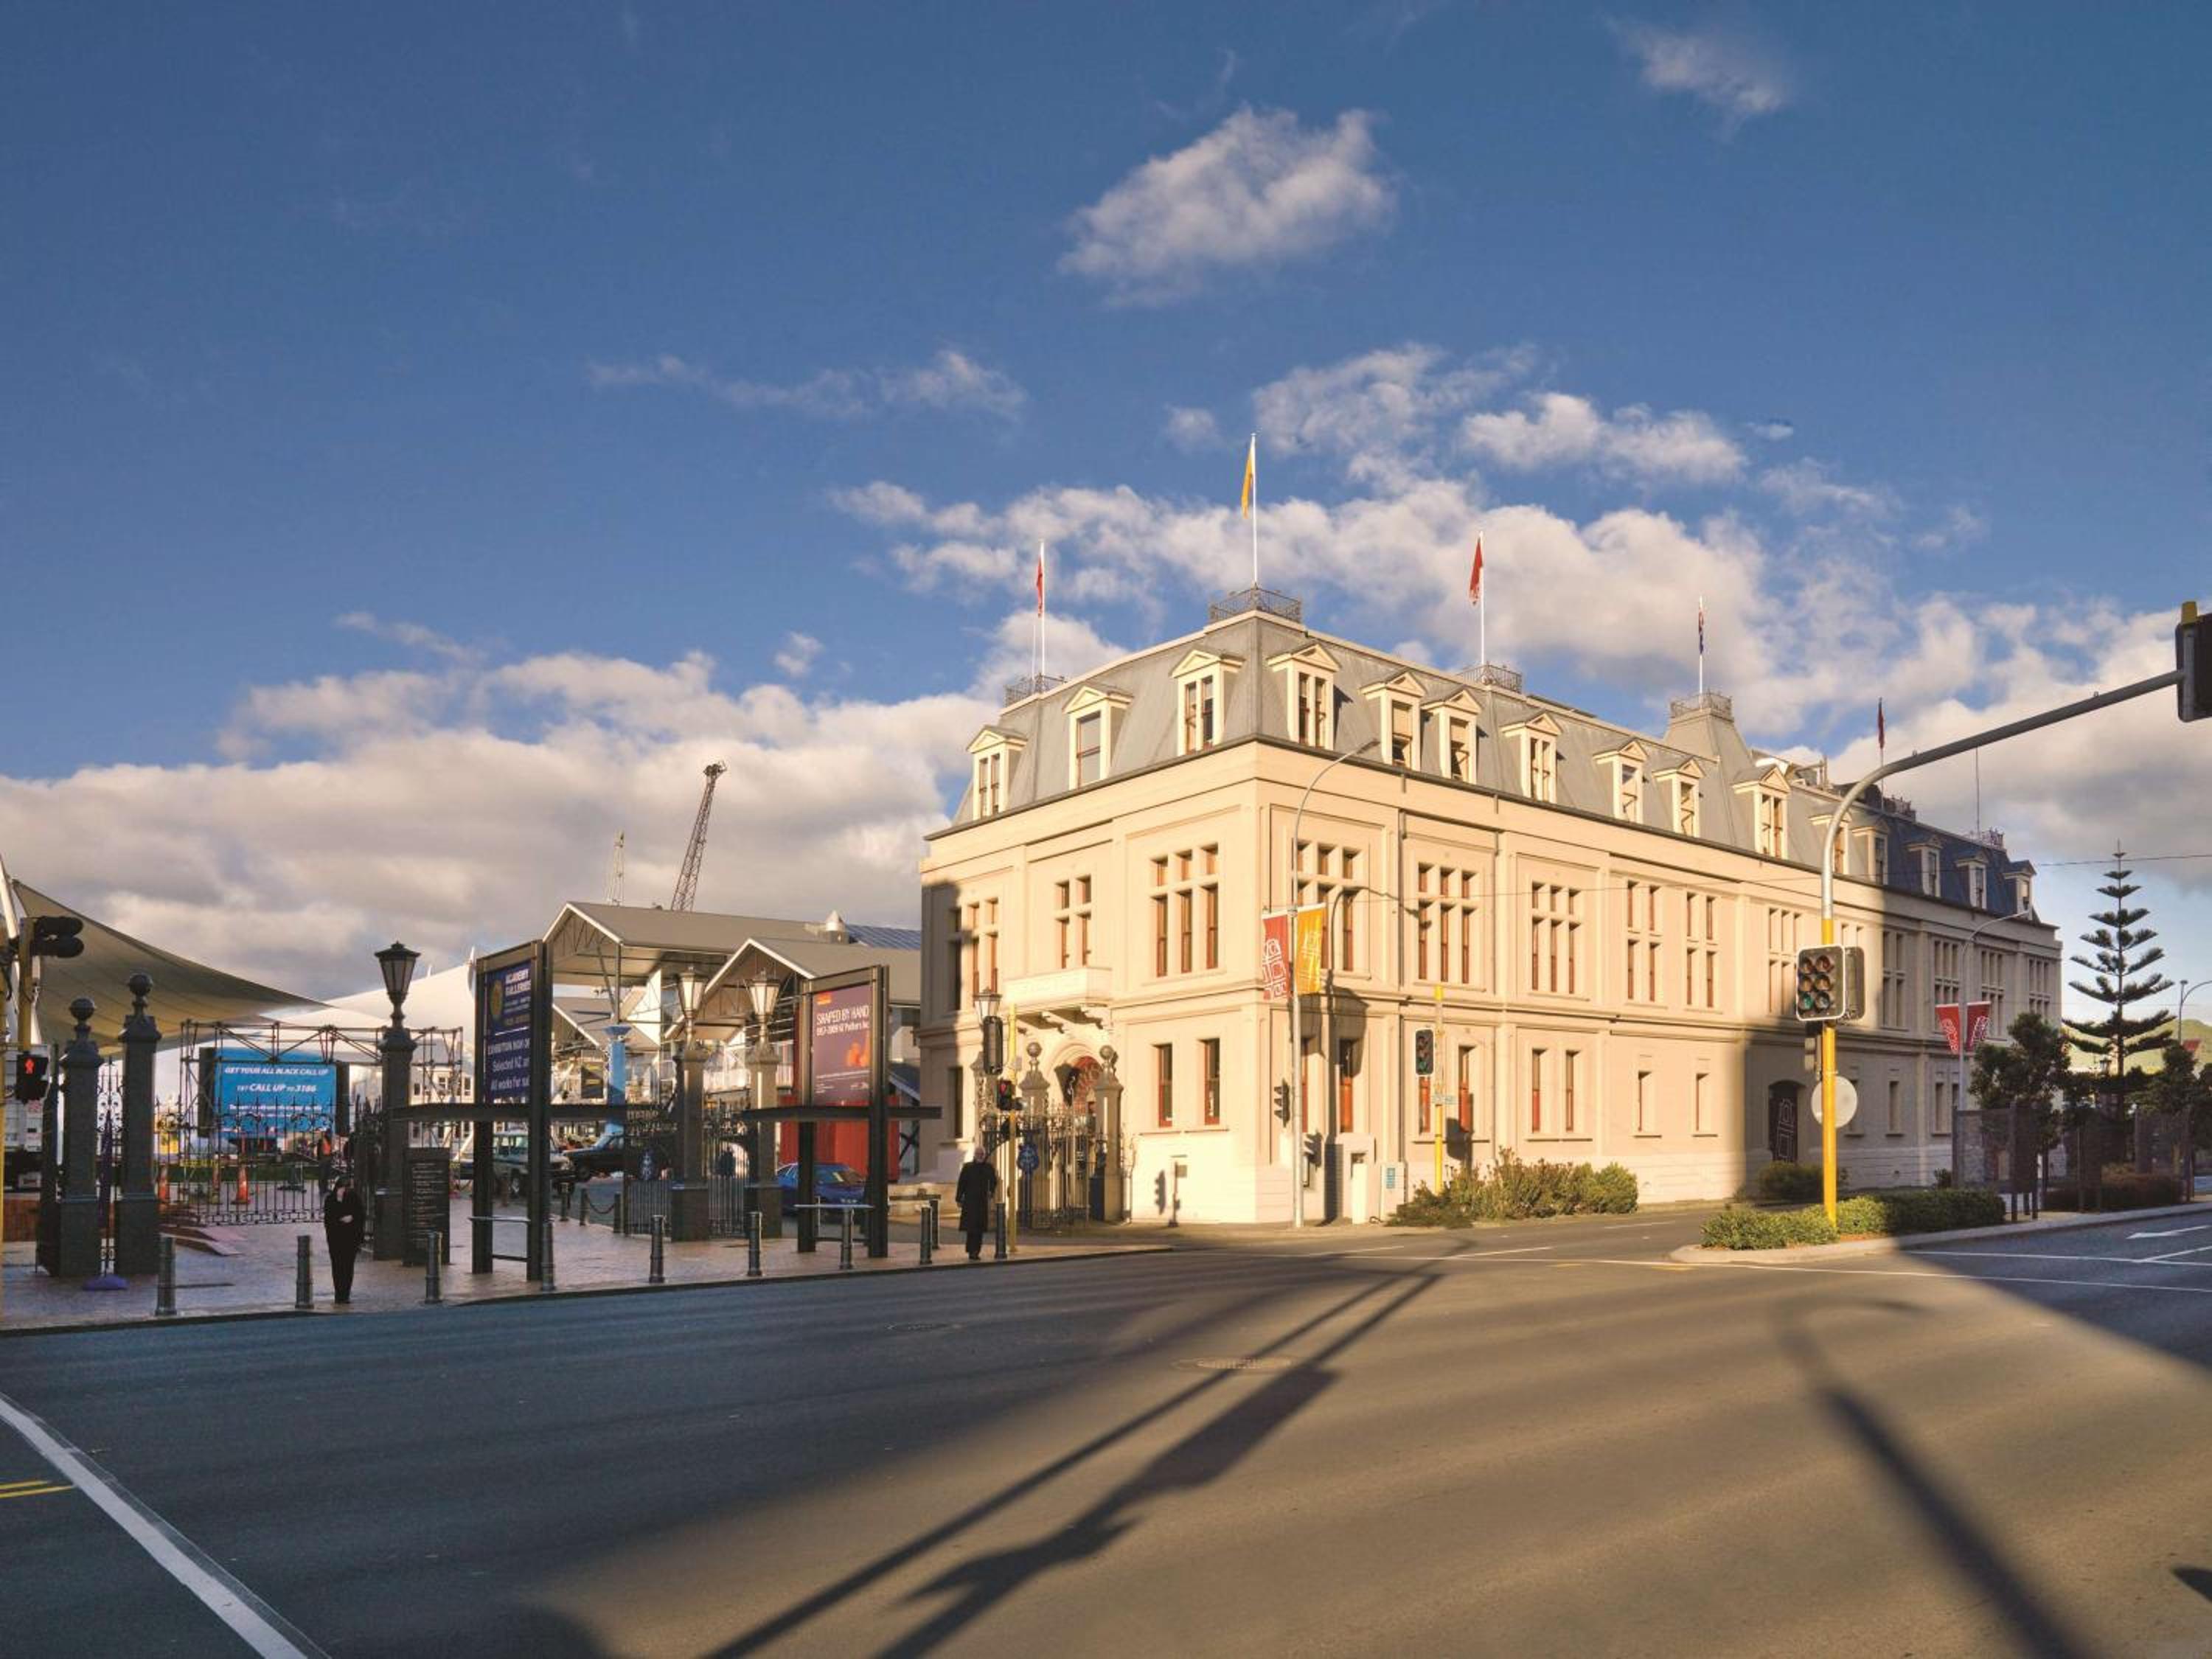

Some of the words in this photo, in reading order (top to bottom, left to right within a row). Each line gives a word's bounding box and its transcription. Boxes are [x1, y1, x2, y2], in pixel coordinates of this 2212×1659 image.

[816, 1009, 841, 1025] SHAPED
[842, 1008, 849, 1021] BY
[851, 1005, 869, 1019] HAND
[513, 1039, 524, 1051] NOW
[493, 1058, 514, 1072] Selected
[515, 1056, 522, 1068] NZ
[276, 1067, 299, 1075] BLACK
[299, 1068, 317, 1076] CALL
[249, 1083, 271, 1092] CALL
[272, 1083, 286, 1092] UP
[498, 1079, 512, 1089] works
[522, 1075, 530, 1087] sal
